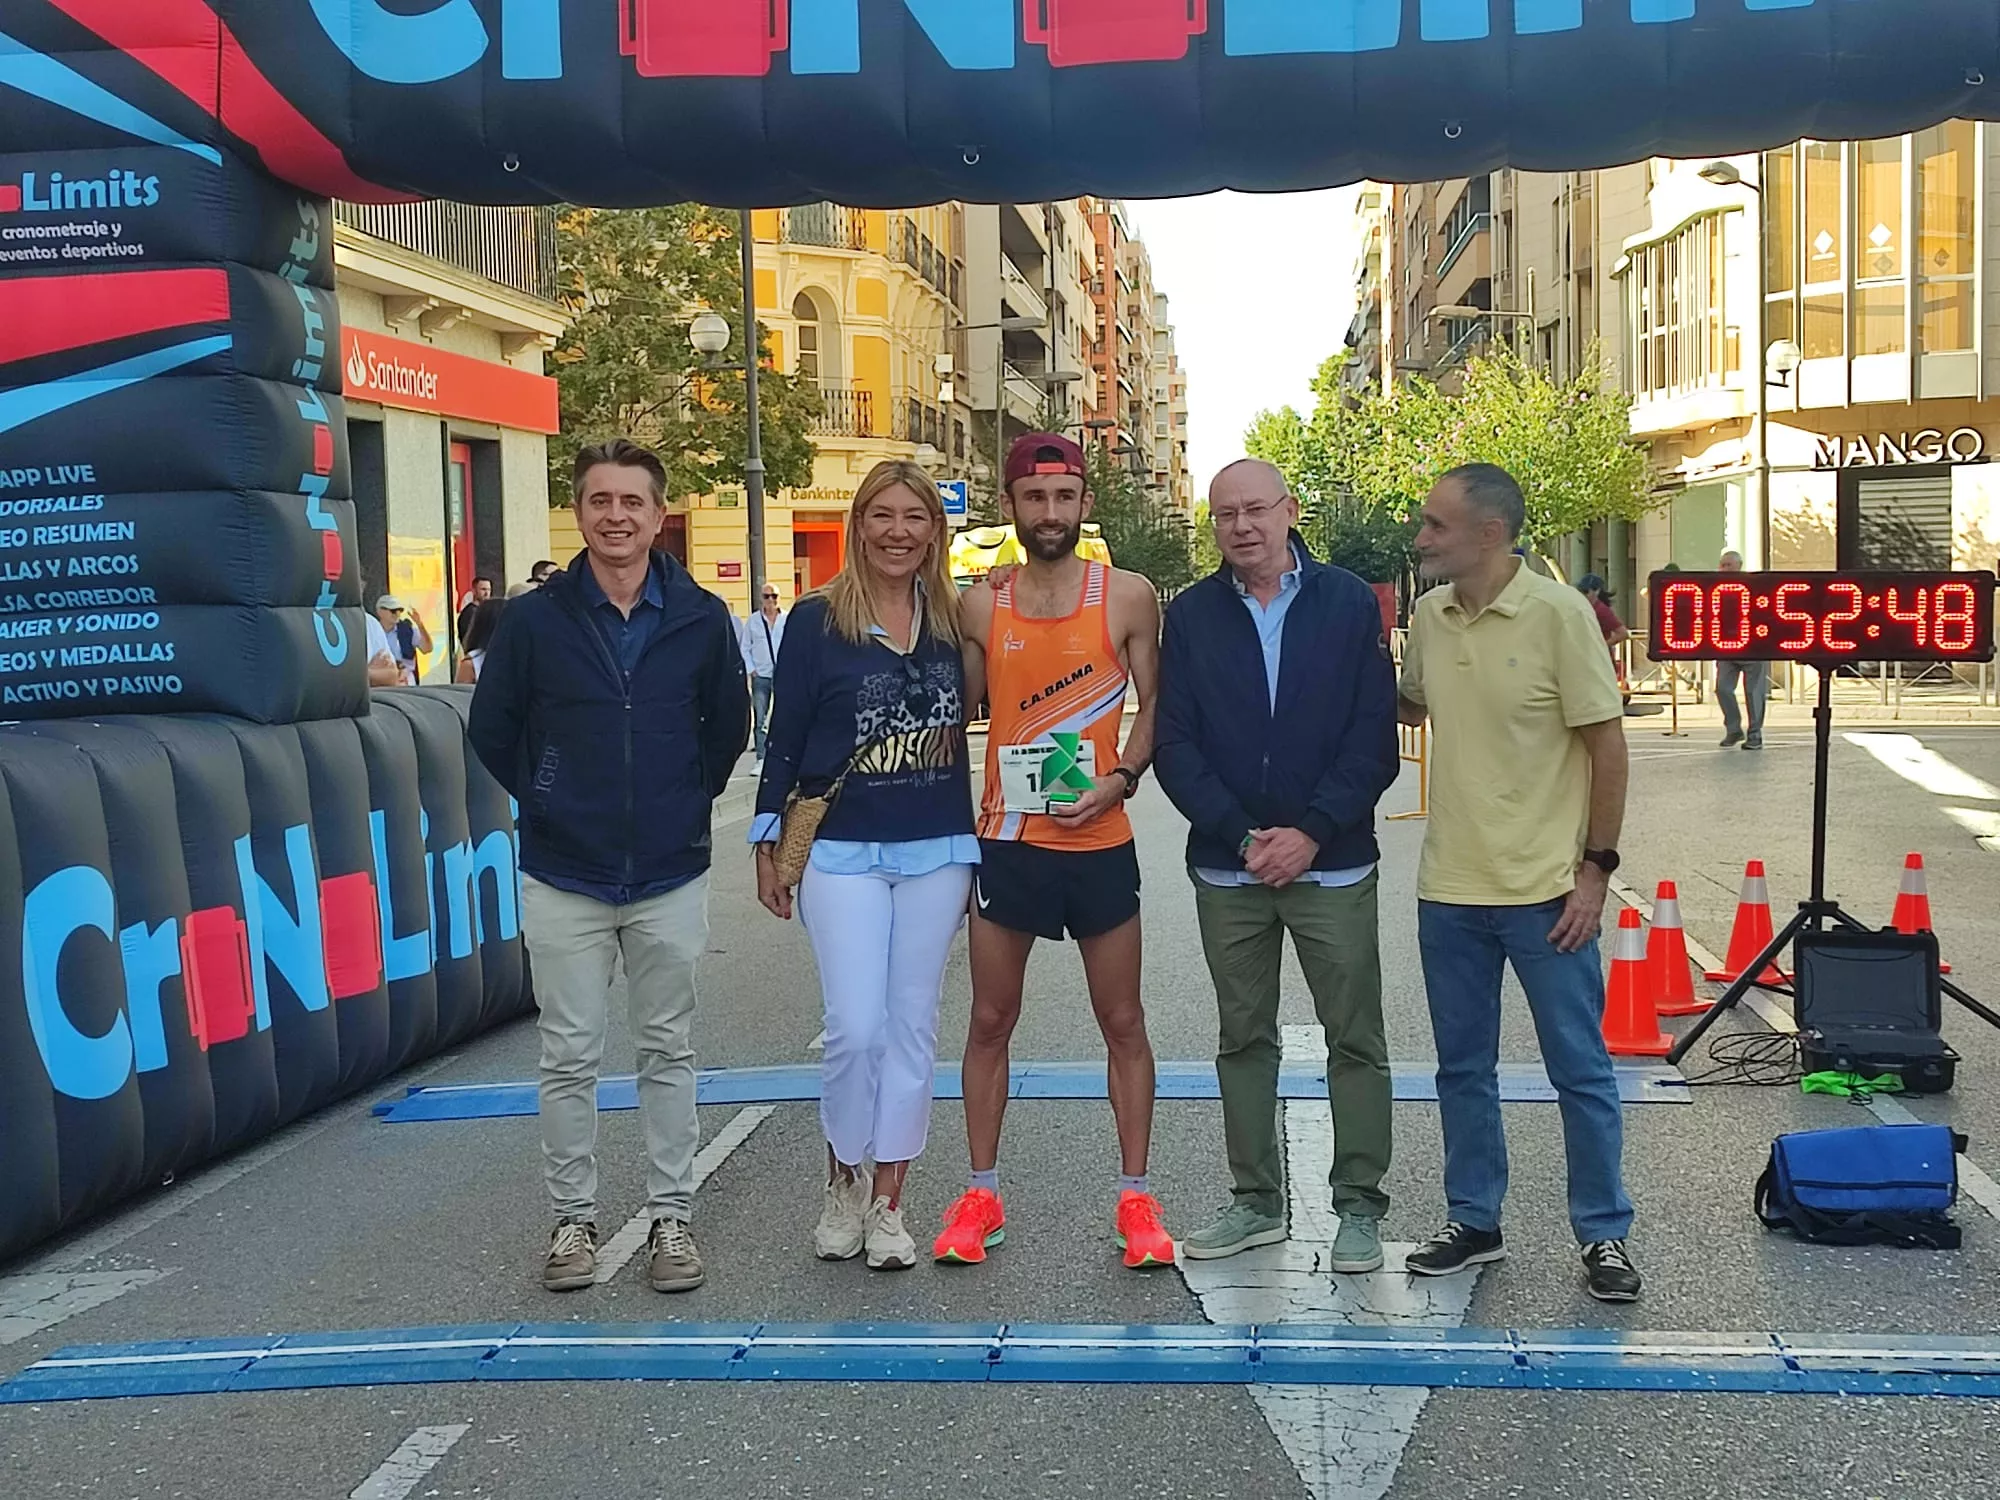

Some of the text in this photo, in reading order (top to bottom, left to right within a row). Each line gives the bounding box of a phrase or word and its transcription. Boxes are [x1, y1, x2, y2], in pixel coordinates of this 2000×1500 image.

[2, 220, 122, 240] cronometraje y
[0, 242, 144, 262] eventos deportivos
[367, 351, 438, 400] Santander
[1814, 426, 1984, 468] MANGO
[0, 464, 96, 488] APP LIVE
[0, 495, 104, 517] DORSALES
[33, 522, 135, 546] RESUMEN
[45, 559, 61, 578] Y
[67, 554, 139, 577] ARCOS
[34, 587, 157, 609] CORREDOR
[0, 612, 160, 639] AKER Y SONIDO
[1664, 583, 1975, 650] 00:52:48
[41, 649, 56, 669] Y
[61, 642, 175, 667] MEDALLAS
[3, 675, 183, 704] ACTIVO Y PASIVO
